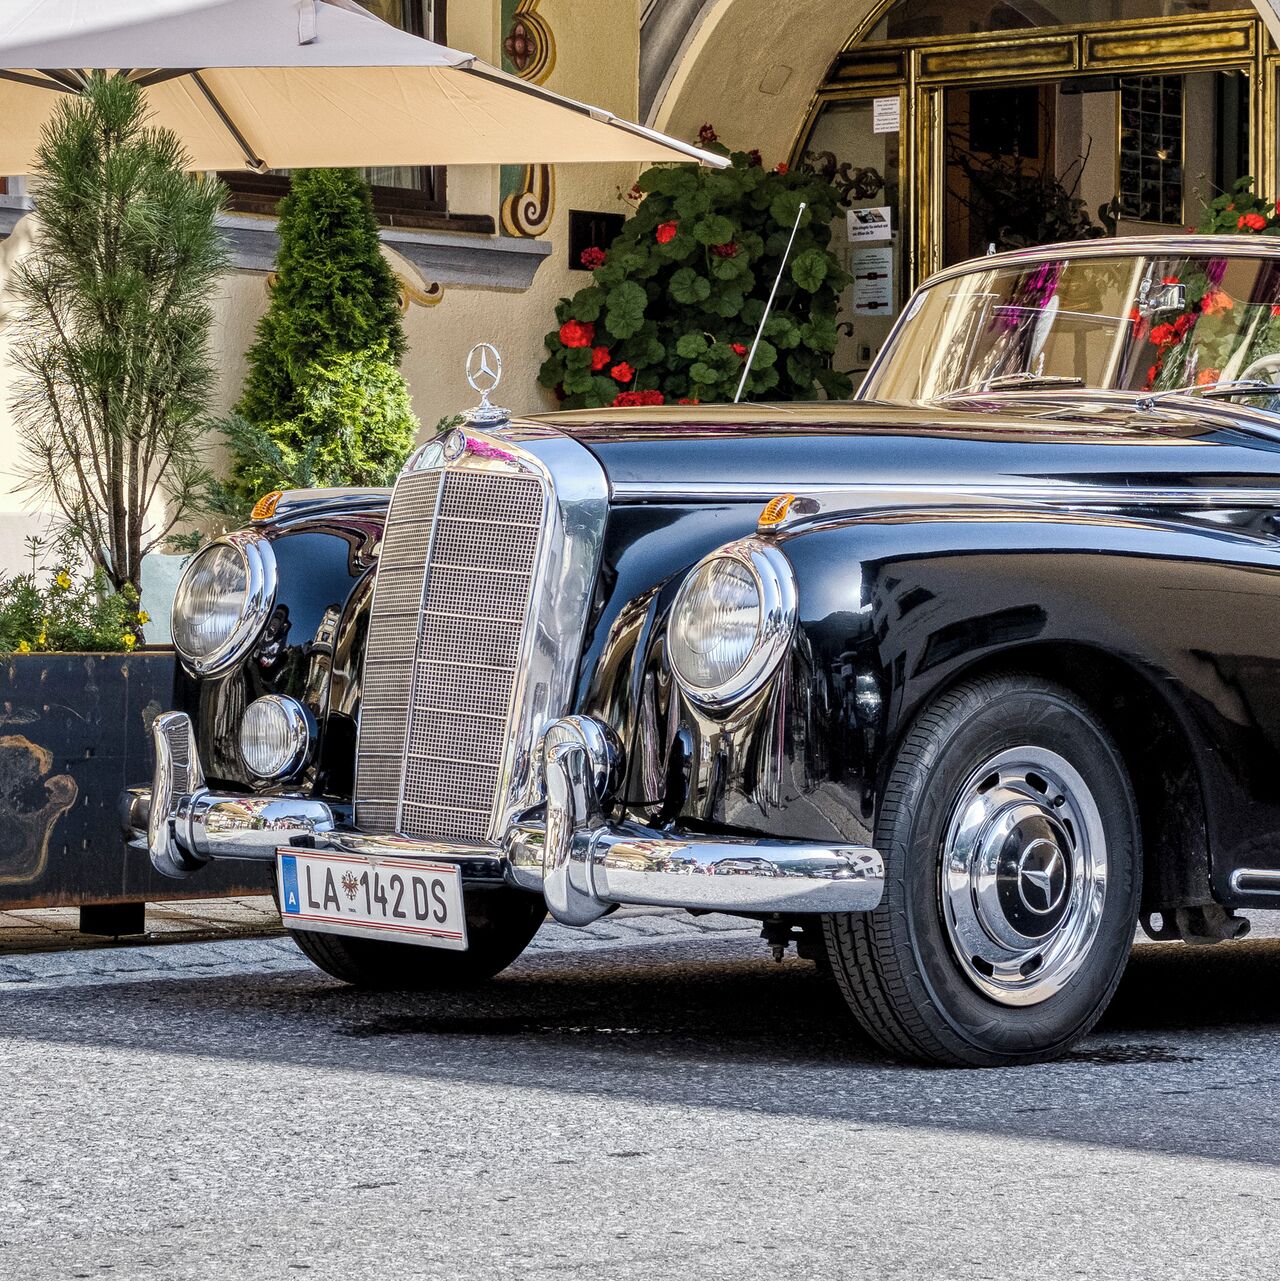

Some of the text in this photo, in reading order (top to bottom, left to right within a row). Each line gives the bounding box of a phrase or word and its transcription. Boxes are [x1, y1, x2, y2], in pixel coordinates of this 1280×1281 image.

[288, 891, 297, 905] A
[306, 864, 448, 924] LA 142 DS
